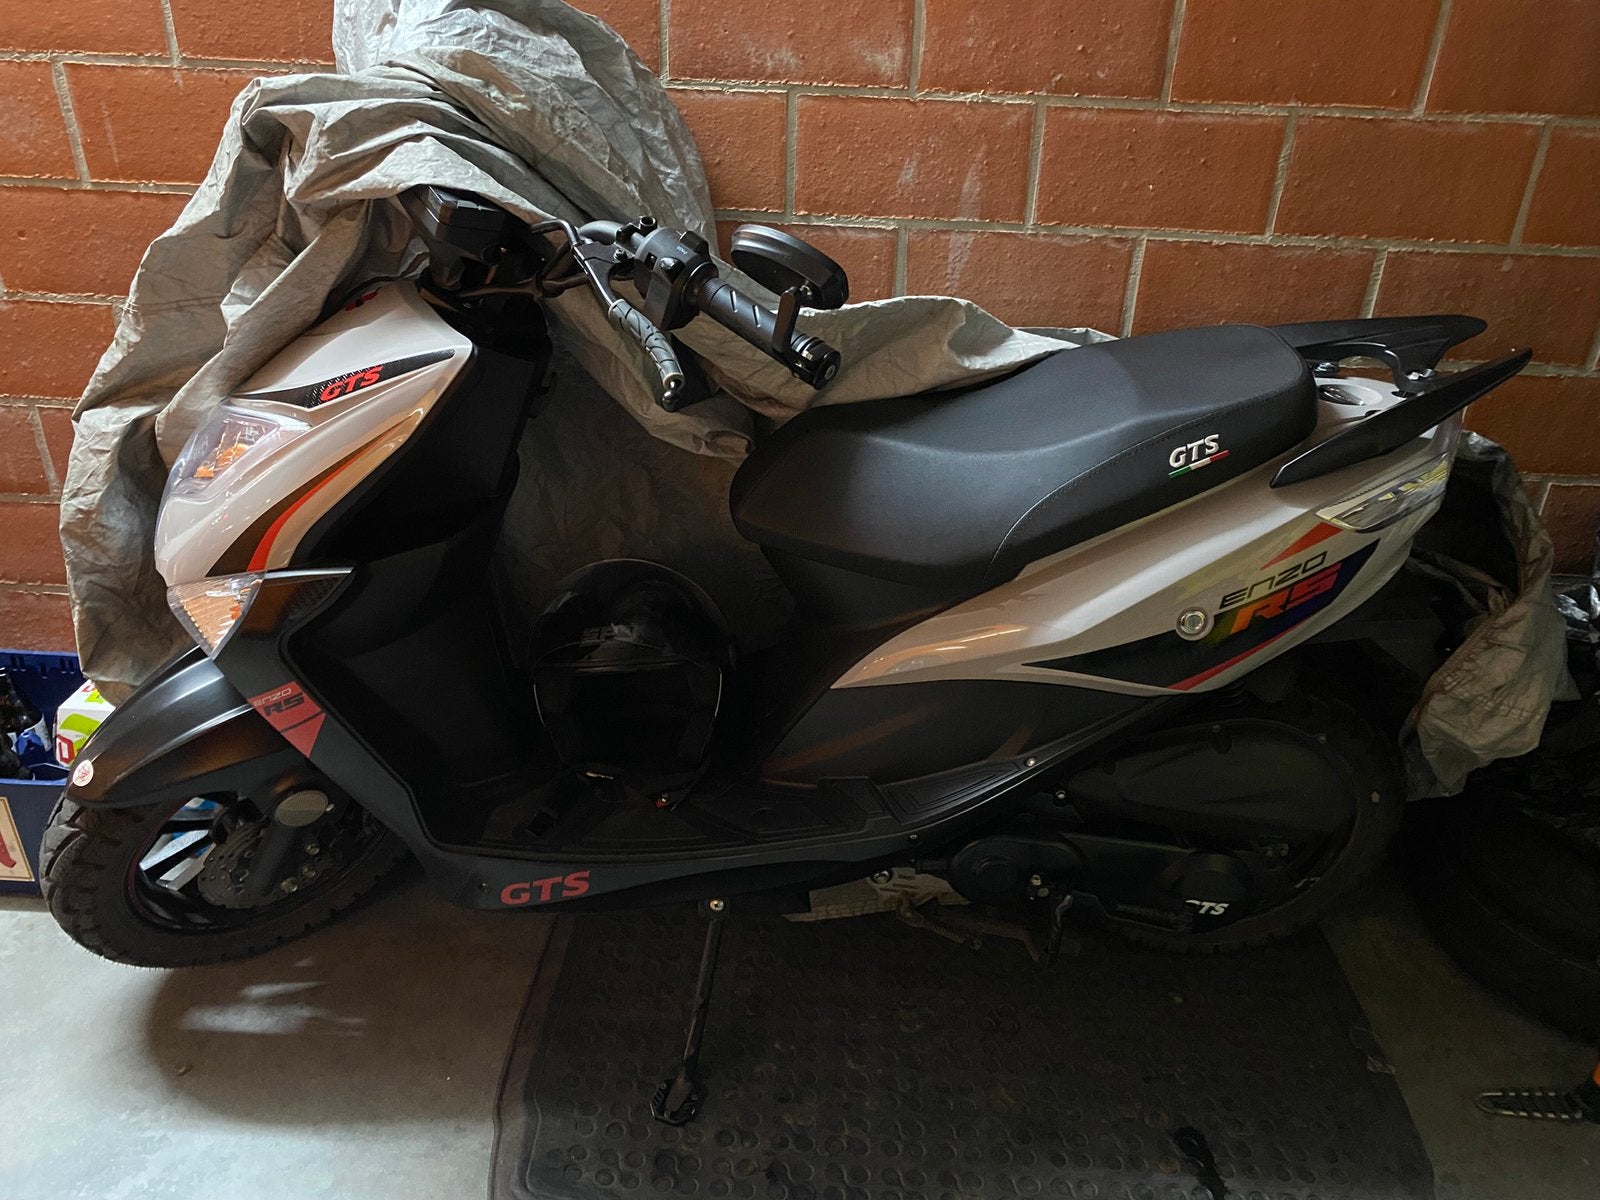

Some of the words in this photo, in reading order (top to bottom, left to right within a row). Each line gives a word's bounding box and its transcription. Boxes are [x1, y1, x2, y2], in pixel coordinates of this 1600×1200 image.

[321, 365, 384, 401] GTS
[1169, 433, 1219, 468] GTS
[1220, 551, 1327, 609] ENZO
[1230, 561, 1342, 634] RS
[264, 692, 304, 716] RS
[501, 870, 589, 905] GTS
[1184, 899, 1230, 916] TS
